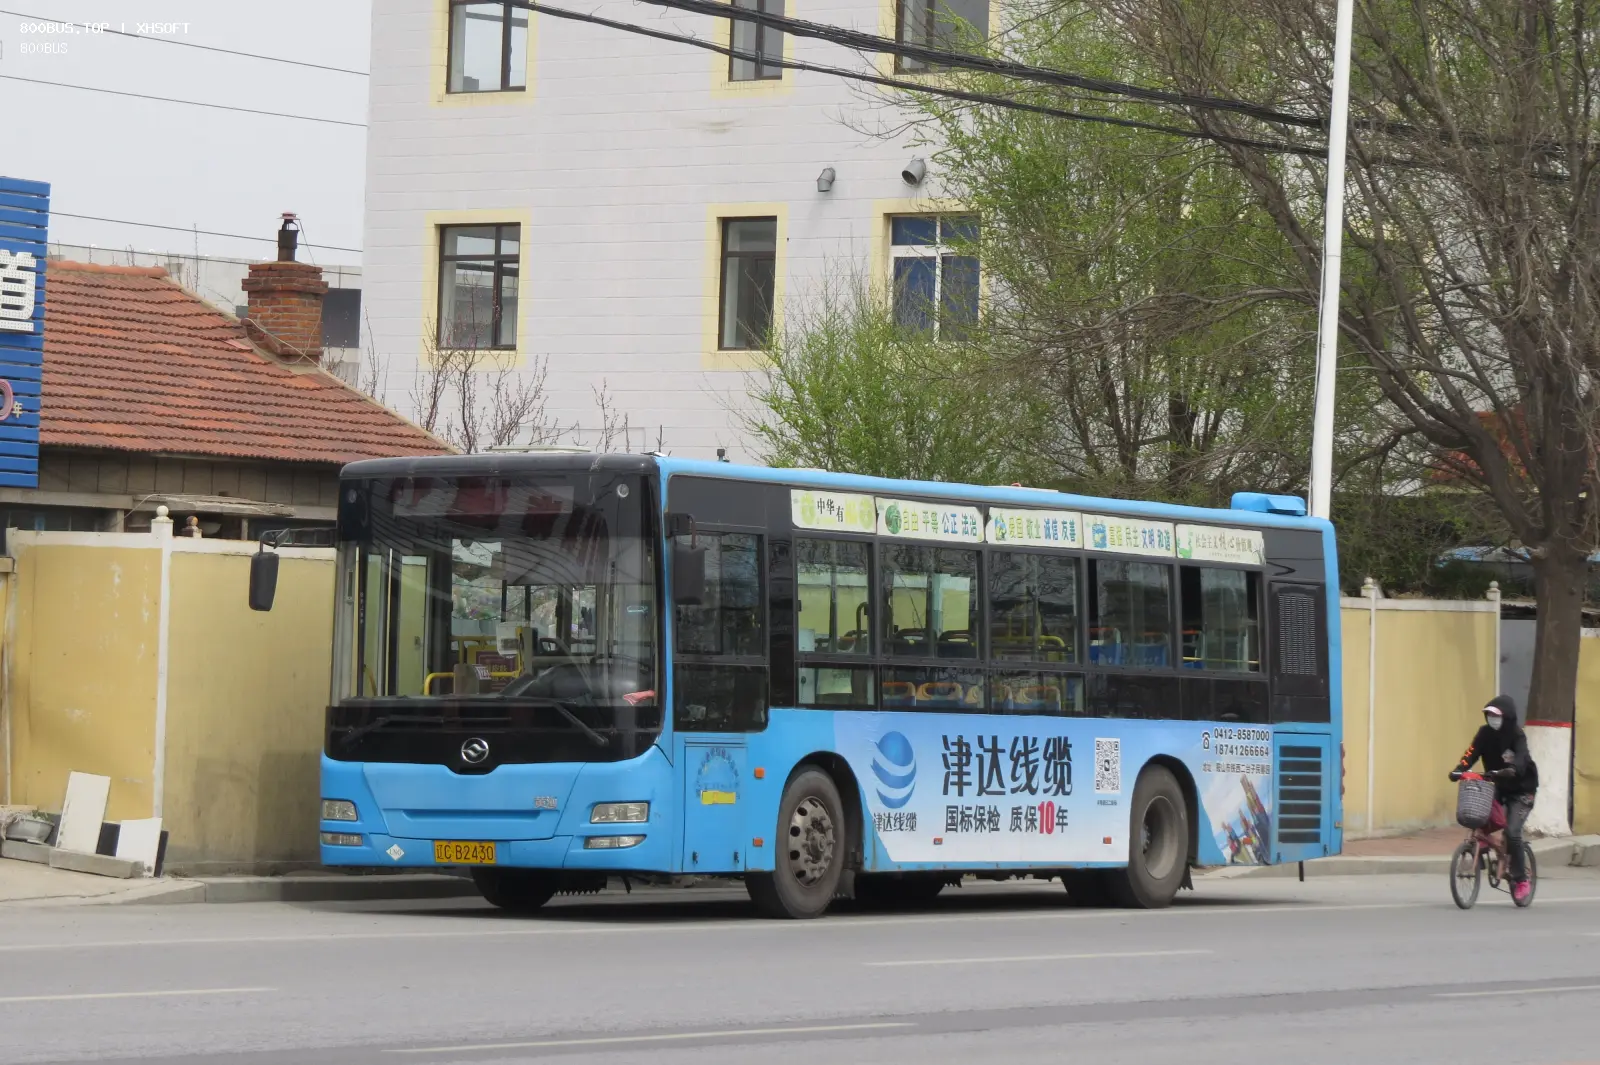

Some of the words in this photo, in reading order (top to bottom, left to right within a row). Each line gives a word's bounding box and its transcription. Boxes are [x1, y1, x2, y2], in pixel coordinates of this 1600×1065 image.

[1213, 727, 1270, 742] 0412-8587000
[1214, 743, 1269, 757] 18741266664
[941, 734, 1073, 797] 津达线缆
[872, 811, 918, 832] 津达线缆
[945, 804, 1000, 833] 国标保检
[1009, 800, 1068, 835] 质保10年
